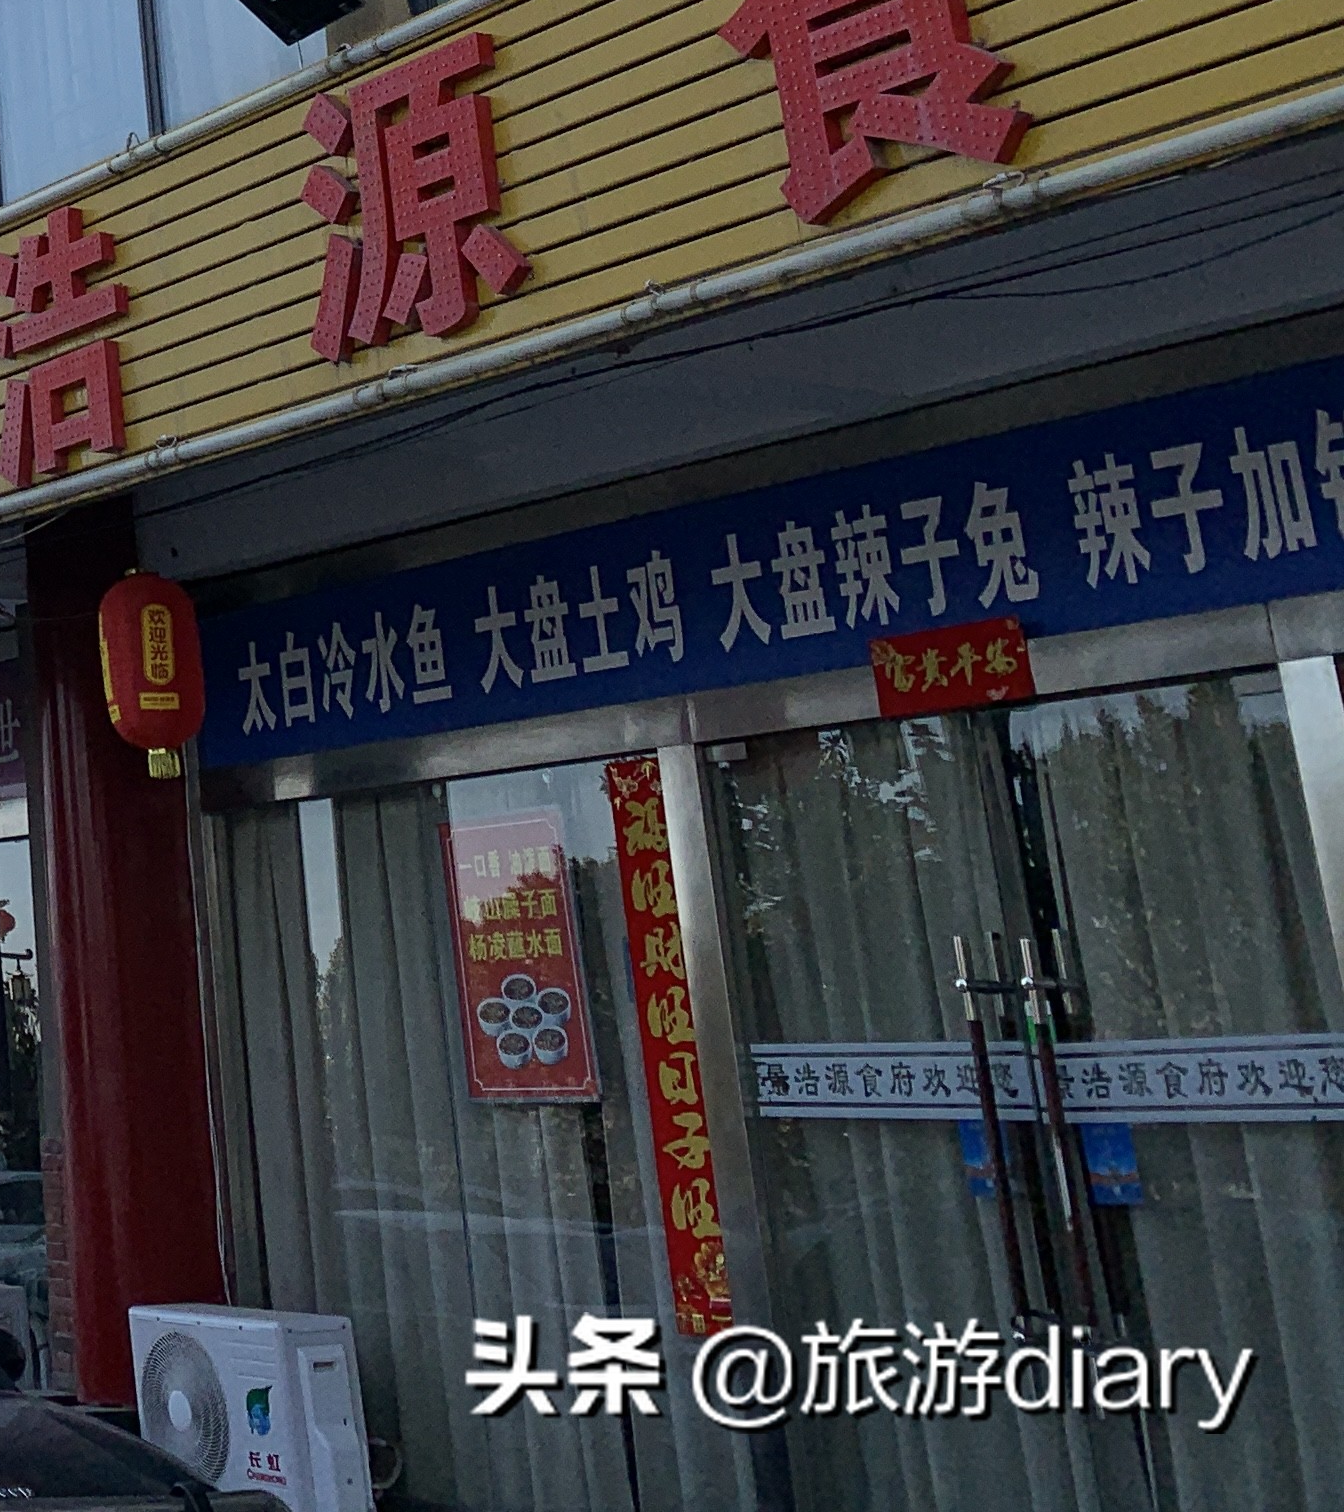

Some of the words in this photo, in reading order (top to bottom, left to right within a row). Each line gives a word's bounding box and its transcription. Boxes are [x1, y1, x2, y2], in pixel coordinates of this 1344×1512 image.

[144, 604, 170, 679] 欢迎光临
[237, 598, 456, 737] 太白冷水鱼
[472, 548, 684, 696] 大盘土鸡
[709, 479, 1041, 654] 大盘辣子兔
[248, 1450, 281, 1473] 长虹
